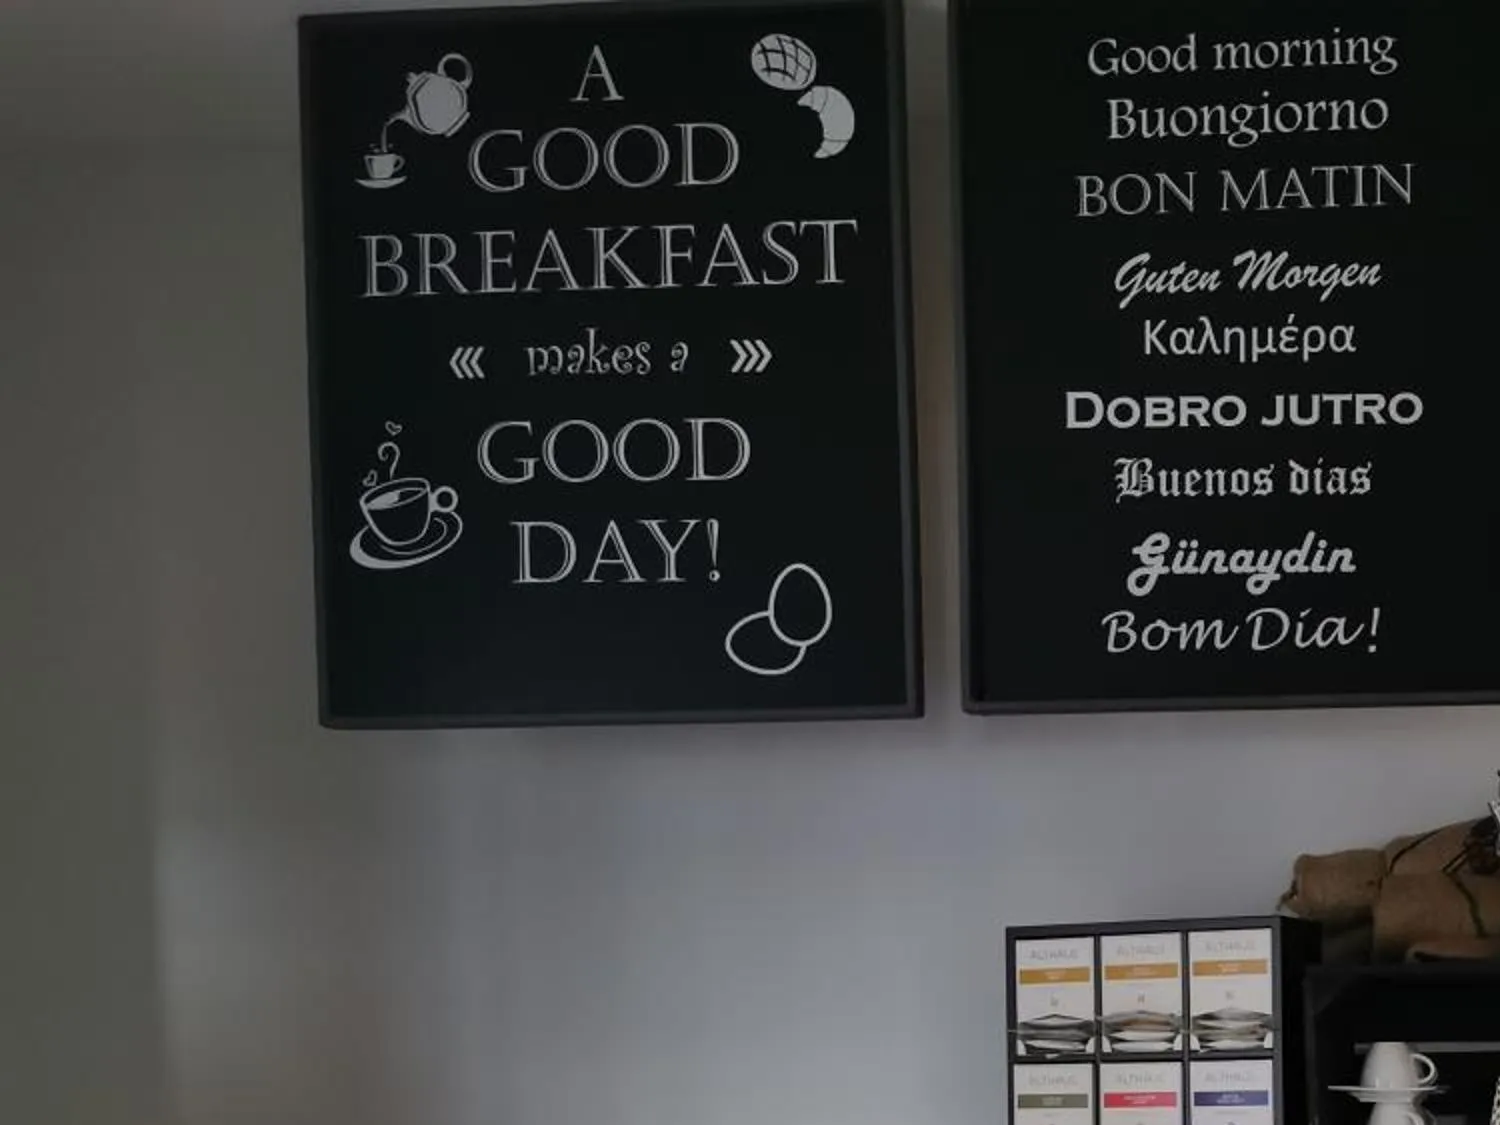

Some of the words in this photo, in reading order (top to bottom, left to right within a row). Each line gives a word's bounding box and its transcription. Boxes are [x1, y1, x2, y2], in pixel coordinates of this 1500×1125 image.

[570, 43, 626, 102] A
[1087, 32, 1198, 77] Good
[1212, 26, 1399, 76] morning
[1106, 89, 1390, 148] Buongiorno
[466, 121, 741, 194] GOOD
[1076, 170, 1198, 218] BON
[1219, 162, 1416, 213] MATIN
[358, 218, 860, 299] BREAKFAST
[1113, 251, 1221, 310] Guten
[1230, 248, 1383, 303] Morgen
[526, 326, 652, 377] makes
[669, 342, 690, 373] a
[1143, 312, 1358, 363] Καλημέρα
[1064, 390, 1248, 430] DOBRO
[1260, 391, 1425, 428] JUTRO
[475, 415, 752, 485] GOOD
[1113, 456, 1276, 505] Buenos
[509, 517, 722, 584] DAY!
[1125, 529, 1358, 598] Günaydin
[1100, 609, 1239, 654] Bom
